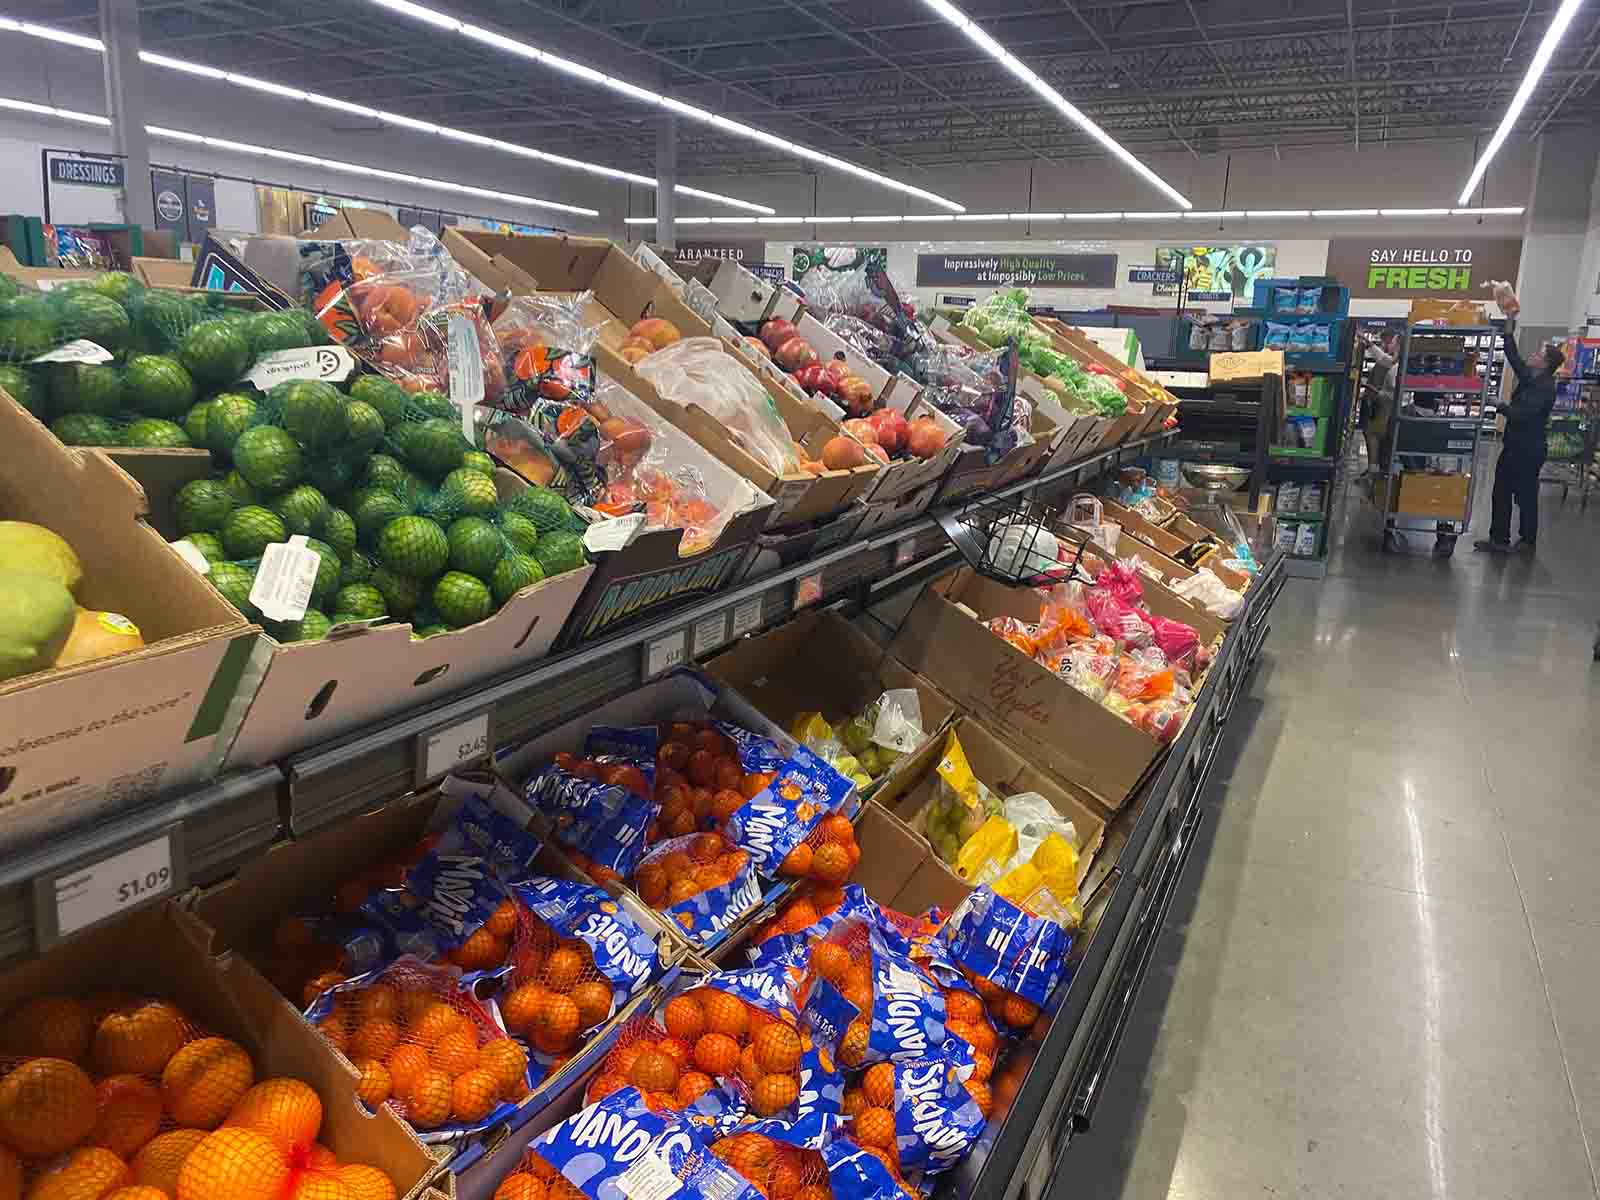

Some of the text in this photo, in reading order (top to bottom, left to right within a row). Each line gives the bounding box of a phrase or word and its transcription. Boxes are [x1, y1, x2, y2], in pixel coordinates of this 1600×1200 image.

[58, 161, 116, 183] DRESSINGS
[674, 248, 744, 260] ARANTEED
[1370, 249, 1472, 262] SAY HELLO TO
[944, 257, 1056, 271] Impressively High Quality
[977, 270, 1085, 283] at Impossibly Low Prices
[1136, 271, 1176, 281] CRACKERS
[1367, 267, 1471, 289] FRESH
[117, 867, 169, 902] $1.09
